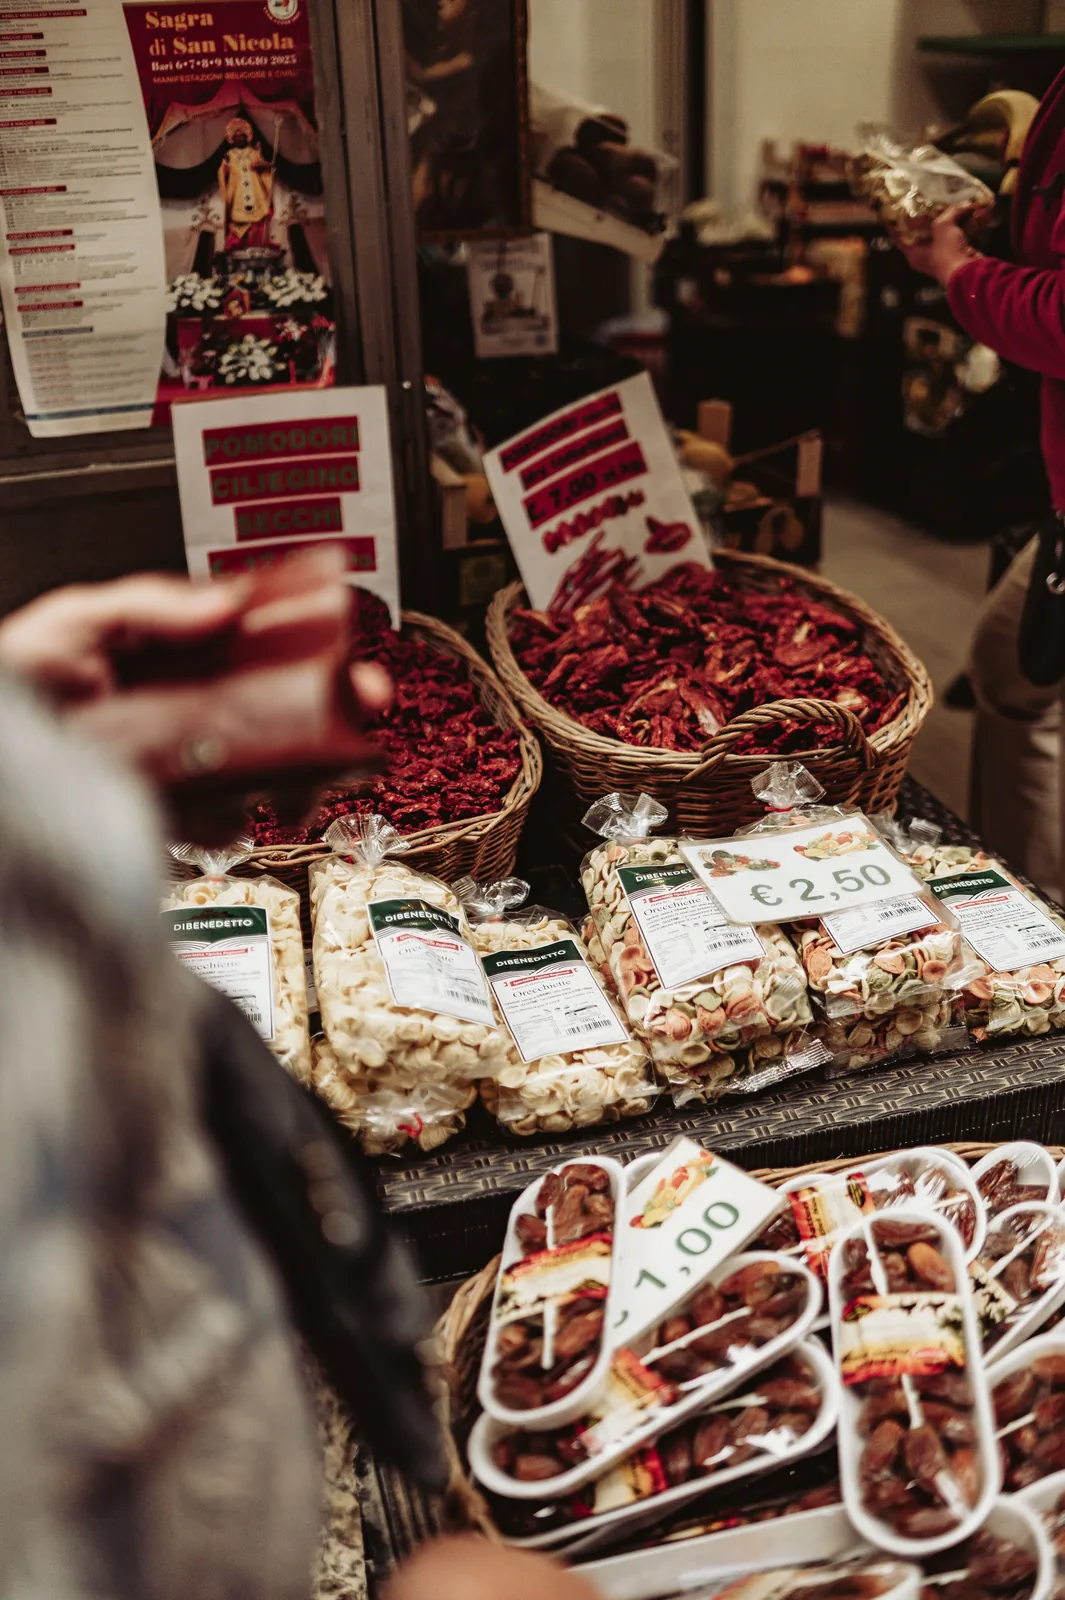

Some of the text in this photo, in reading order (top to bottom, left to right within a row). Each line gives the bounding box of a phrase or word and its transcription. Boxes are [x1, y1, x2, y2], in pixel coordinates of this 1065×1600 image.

[145, 11, 213, 32] Sagra
[149, 32, 294, 55] di San Nicola
[151, 61, 173, 72] Bari
[225, 55, 268, 67] MAGGIO
[270, 53, 297, 65] 2025
[204, 425, 358, 459] POMODORI
[212, 464, 358, 498] CILIEGINO
[238, 507, 341, 536] SECCHI
[635, 868, 693, 883] DIBENEDET
[750, 864, 891, 906] € 2,50
[933, 878, 994, 893] DIBENEDETTO
[643, 897, 701, 916] Orecchiette
[1005, 901, 1023, 910] Tris
[173, 917, 254, 931] DIBENEDETTO
[496, 949, 567, 967] DIBENEDETTO
[513, 979, 572, 998] Orecchiette
[635, 1201, 739, 1288] 1,00
